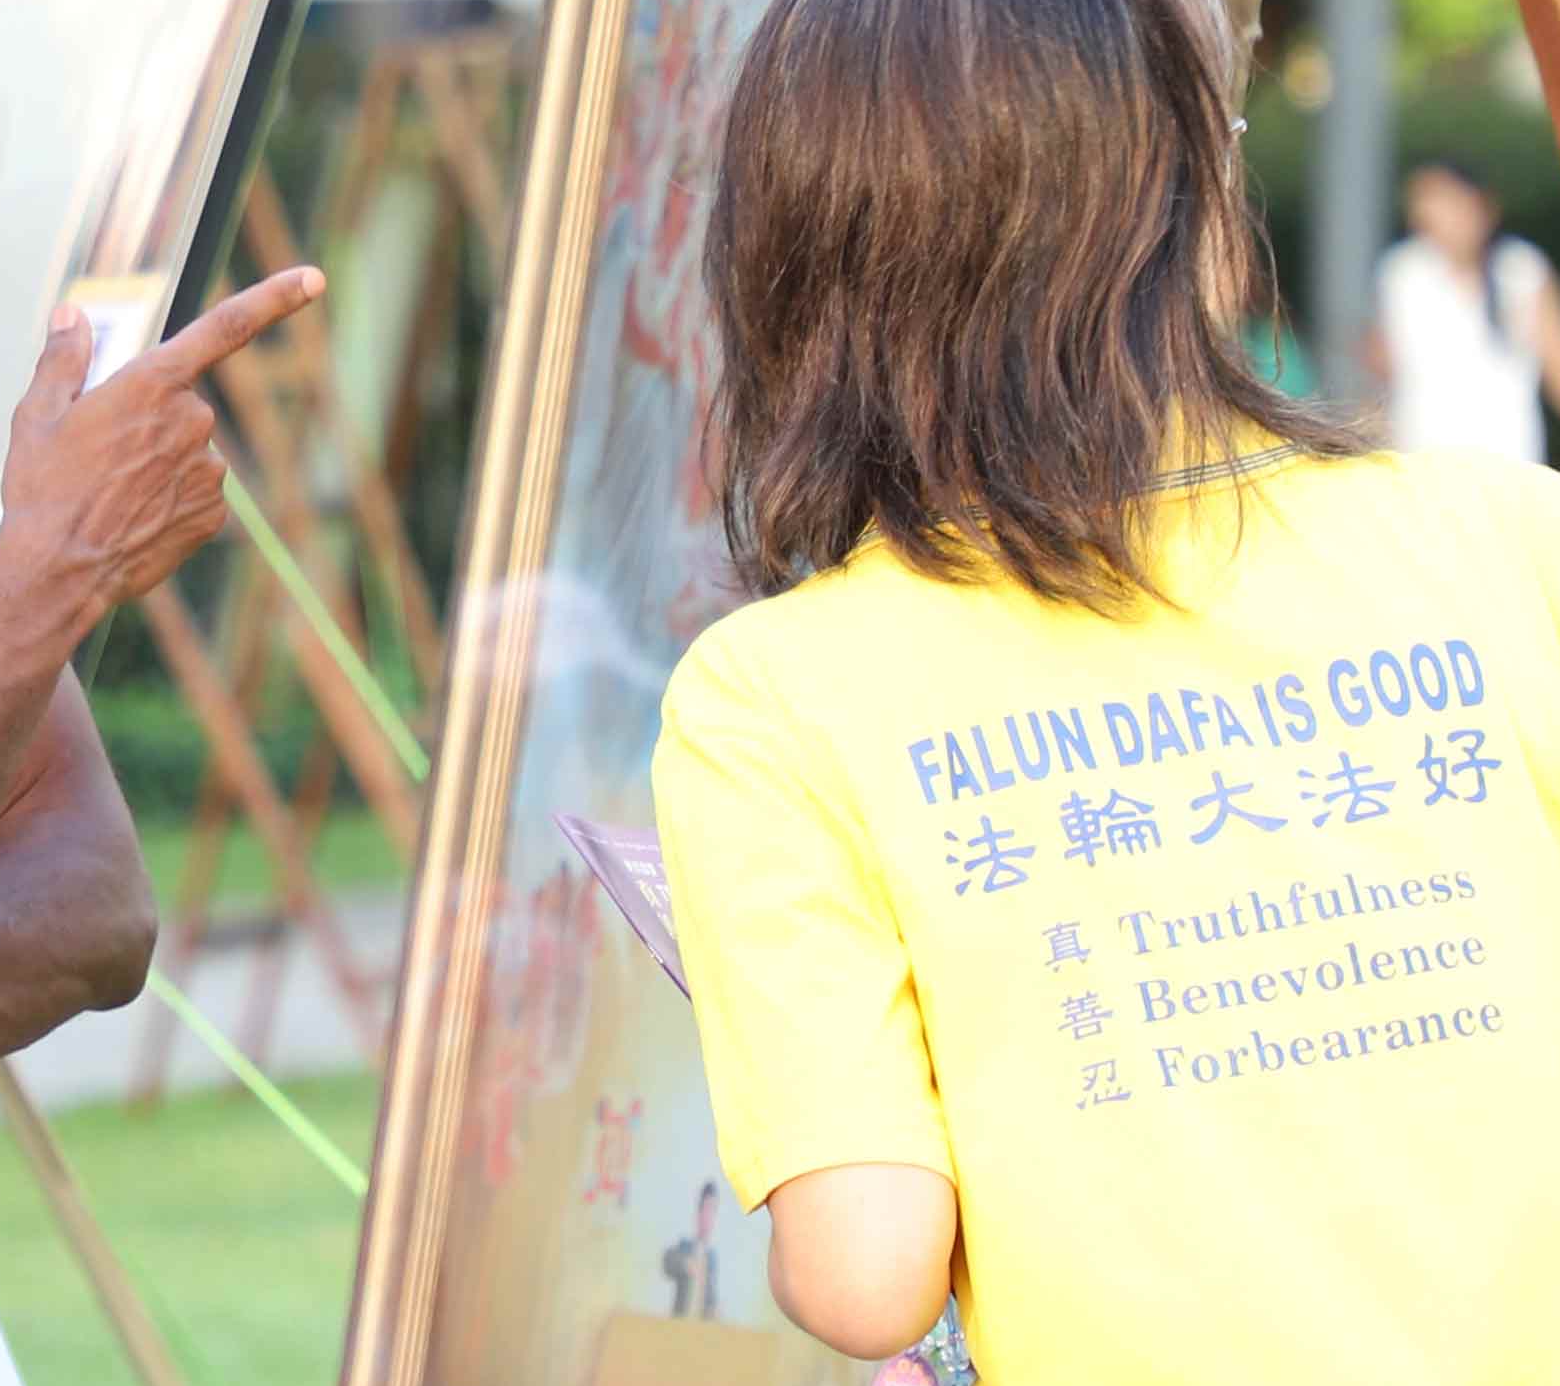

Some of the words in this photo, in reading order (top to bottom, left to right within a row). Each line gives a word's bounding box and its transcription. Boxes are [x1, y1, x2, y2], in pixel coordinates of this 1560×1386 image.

[907, 707, 1098, 805] FALUN
[1102, 689, 1255, 767] DAFA
[1253, 673, 1318, 747] IS
[1326, 639, 1486, 727] GOOD
[943, 728, 1503, 897] 法輪大法好
[1041, 920, 1092, 973] 真
[1118, 870, 1477, 956] Truthfulness
[1057, 992, 1114, 1041] 善
[1137, 935, 1487, 1024] Benevolence
[1075, 1059, 1133, 1111] 忍
[1155, 1002, 1505, 1090] Forbearance
